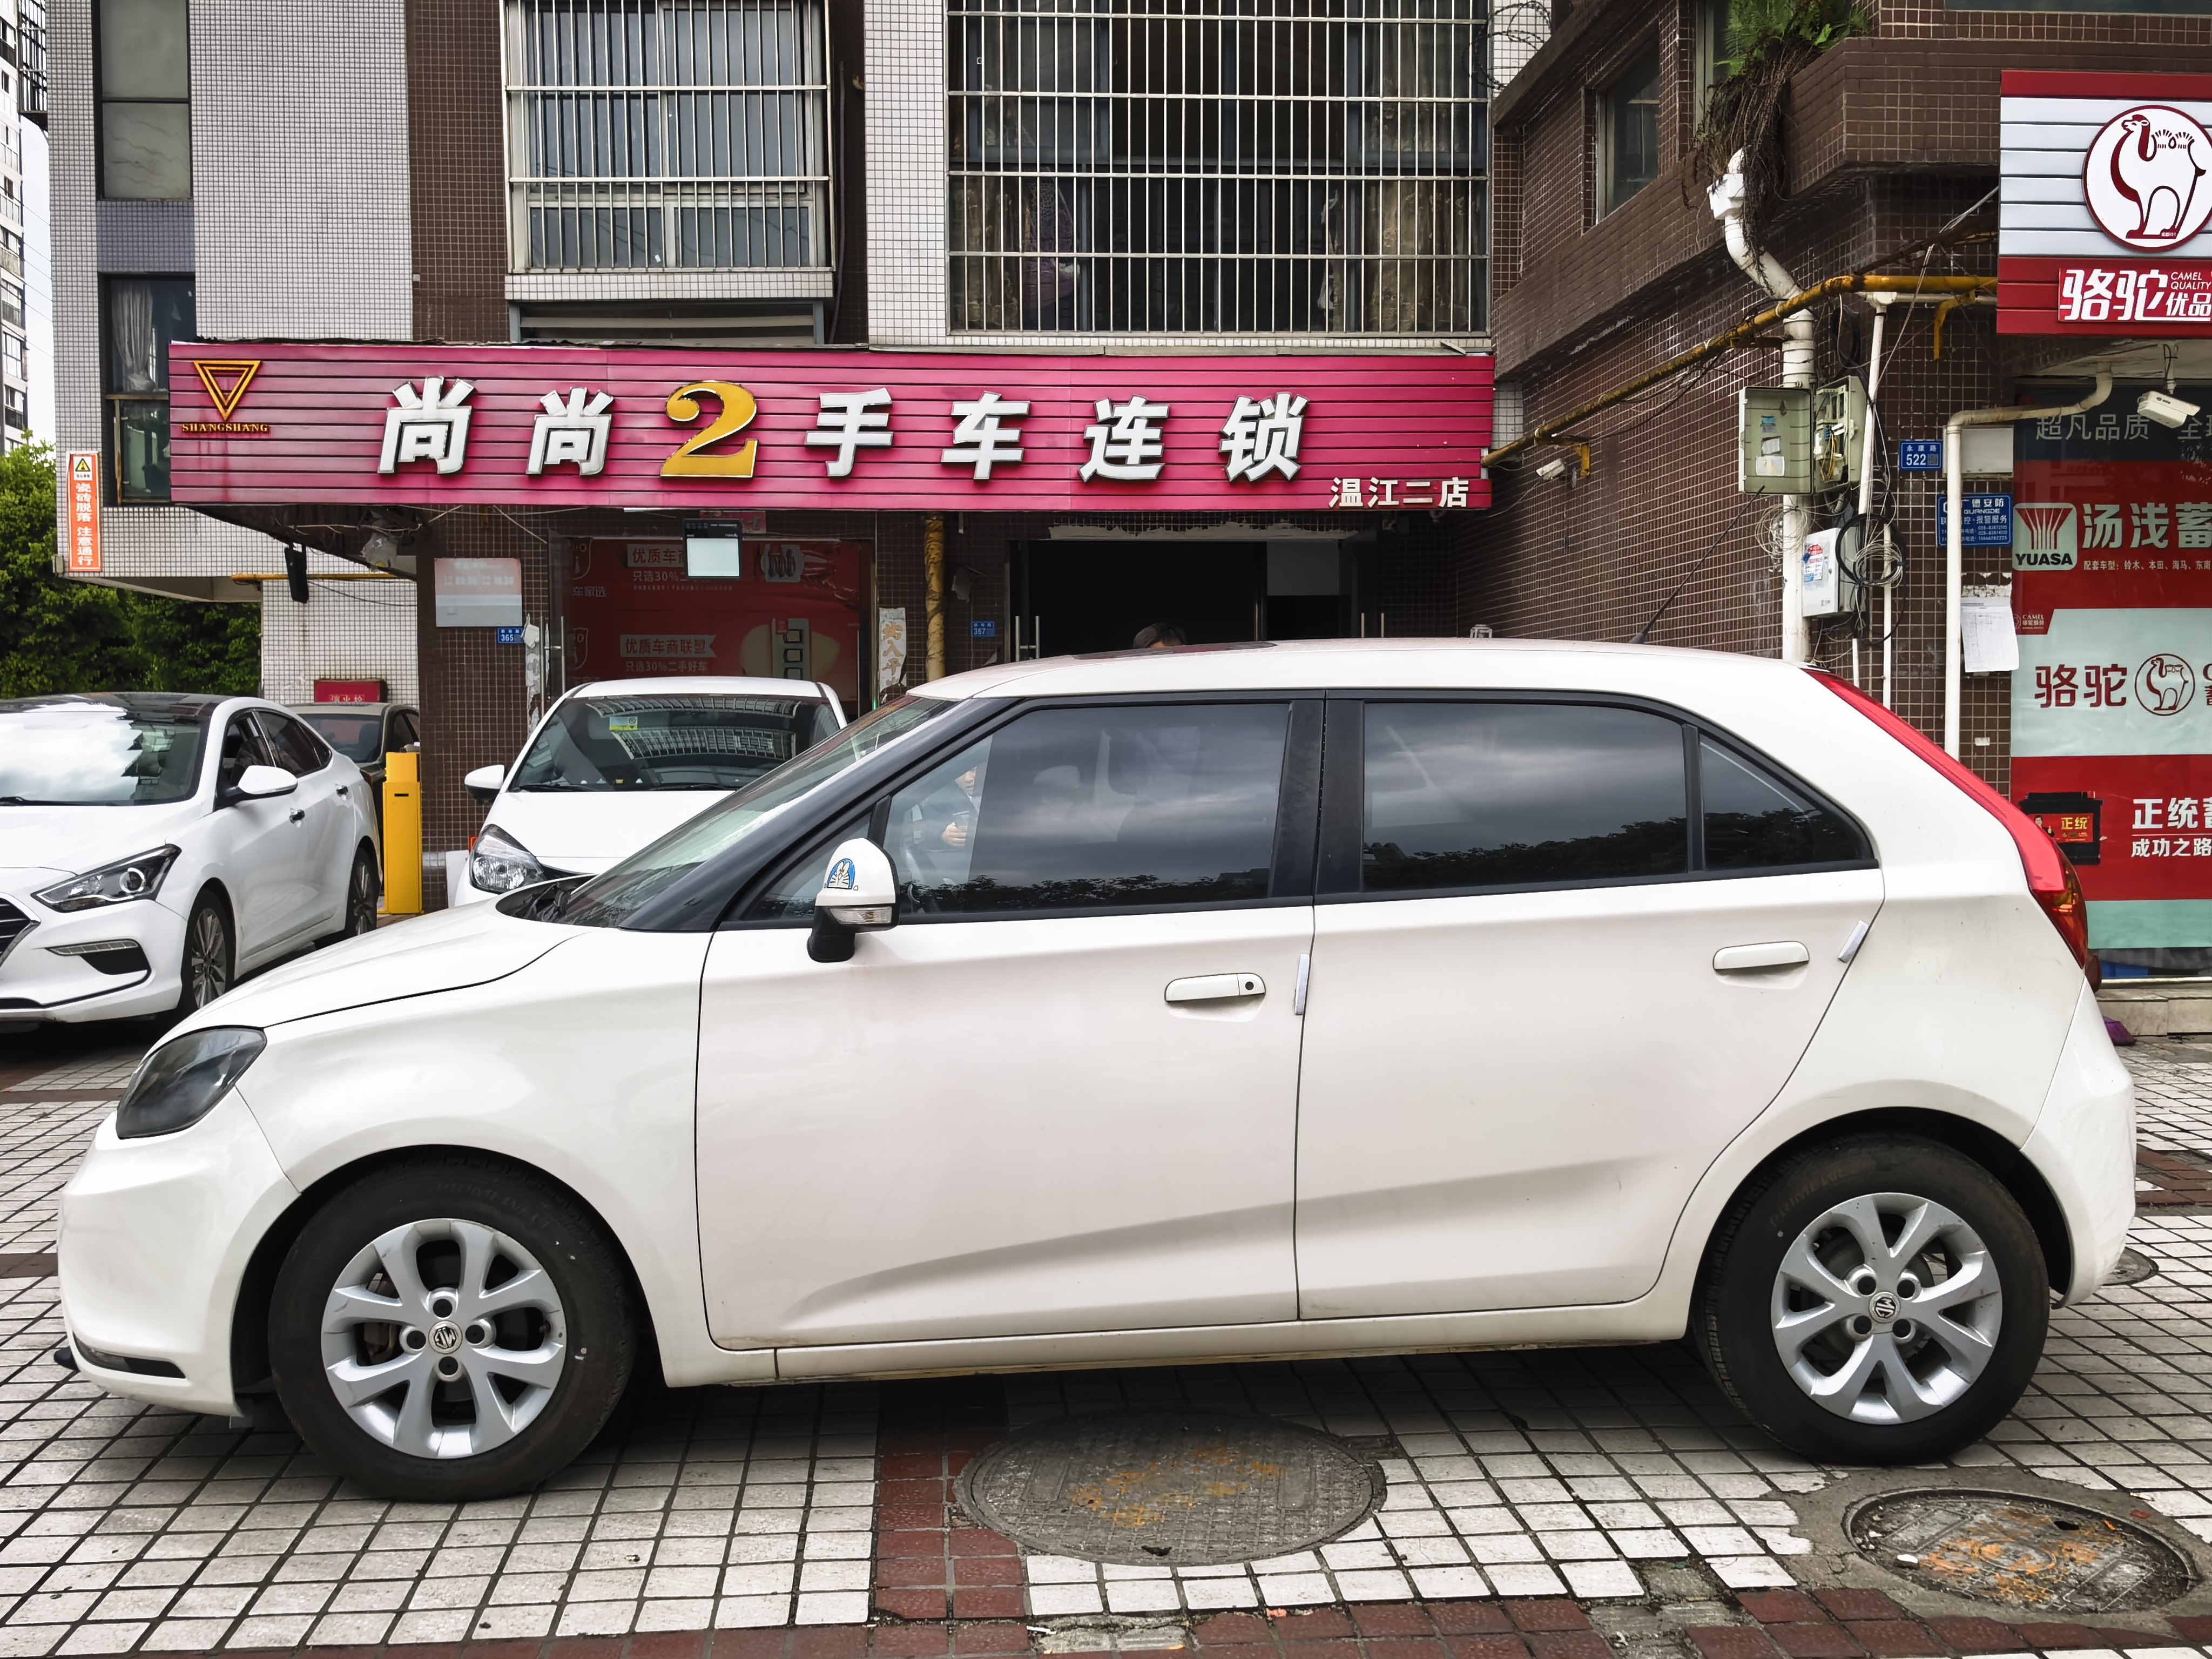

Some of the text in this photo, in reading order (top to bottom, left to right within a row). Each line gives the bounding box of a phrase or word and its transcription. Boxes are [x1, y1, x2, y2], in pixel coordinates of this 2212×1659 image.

[2170, 281, 2211, 290] QUALITY
[2171, 272, 2202, 280] CAMEL
[2060, 269, 2211, 321] 骆驼
[2166, 292, 2211, 316] 优品
[182, 423, 268, 432] SHANGSHANG
[377, 375, 1310, 482] 尚尚2手车连锁
[2036, 414, 2149, 440] 超凡品质
[1906, 454, 1926, 466] 522
[76, 482, 92, 522] 瓷砖脱落
[1328, 476, 1469, 508] 温江二店
[1940, 515, 2007, 525] 联控·报警服务
[2082, 502, 2212, 549] 汤浅蓄
[77, 527, 93, 566] 注意通行
[2015, 553, 2073, 565] YUASA
[625, 639, 706, 655] 优质车商联盟
[2034, 664, 2127, 708] 骆驼
[2061, 817, 2087, 830] 正统
[2131, 838, 2211, 858] 成功之路
